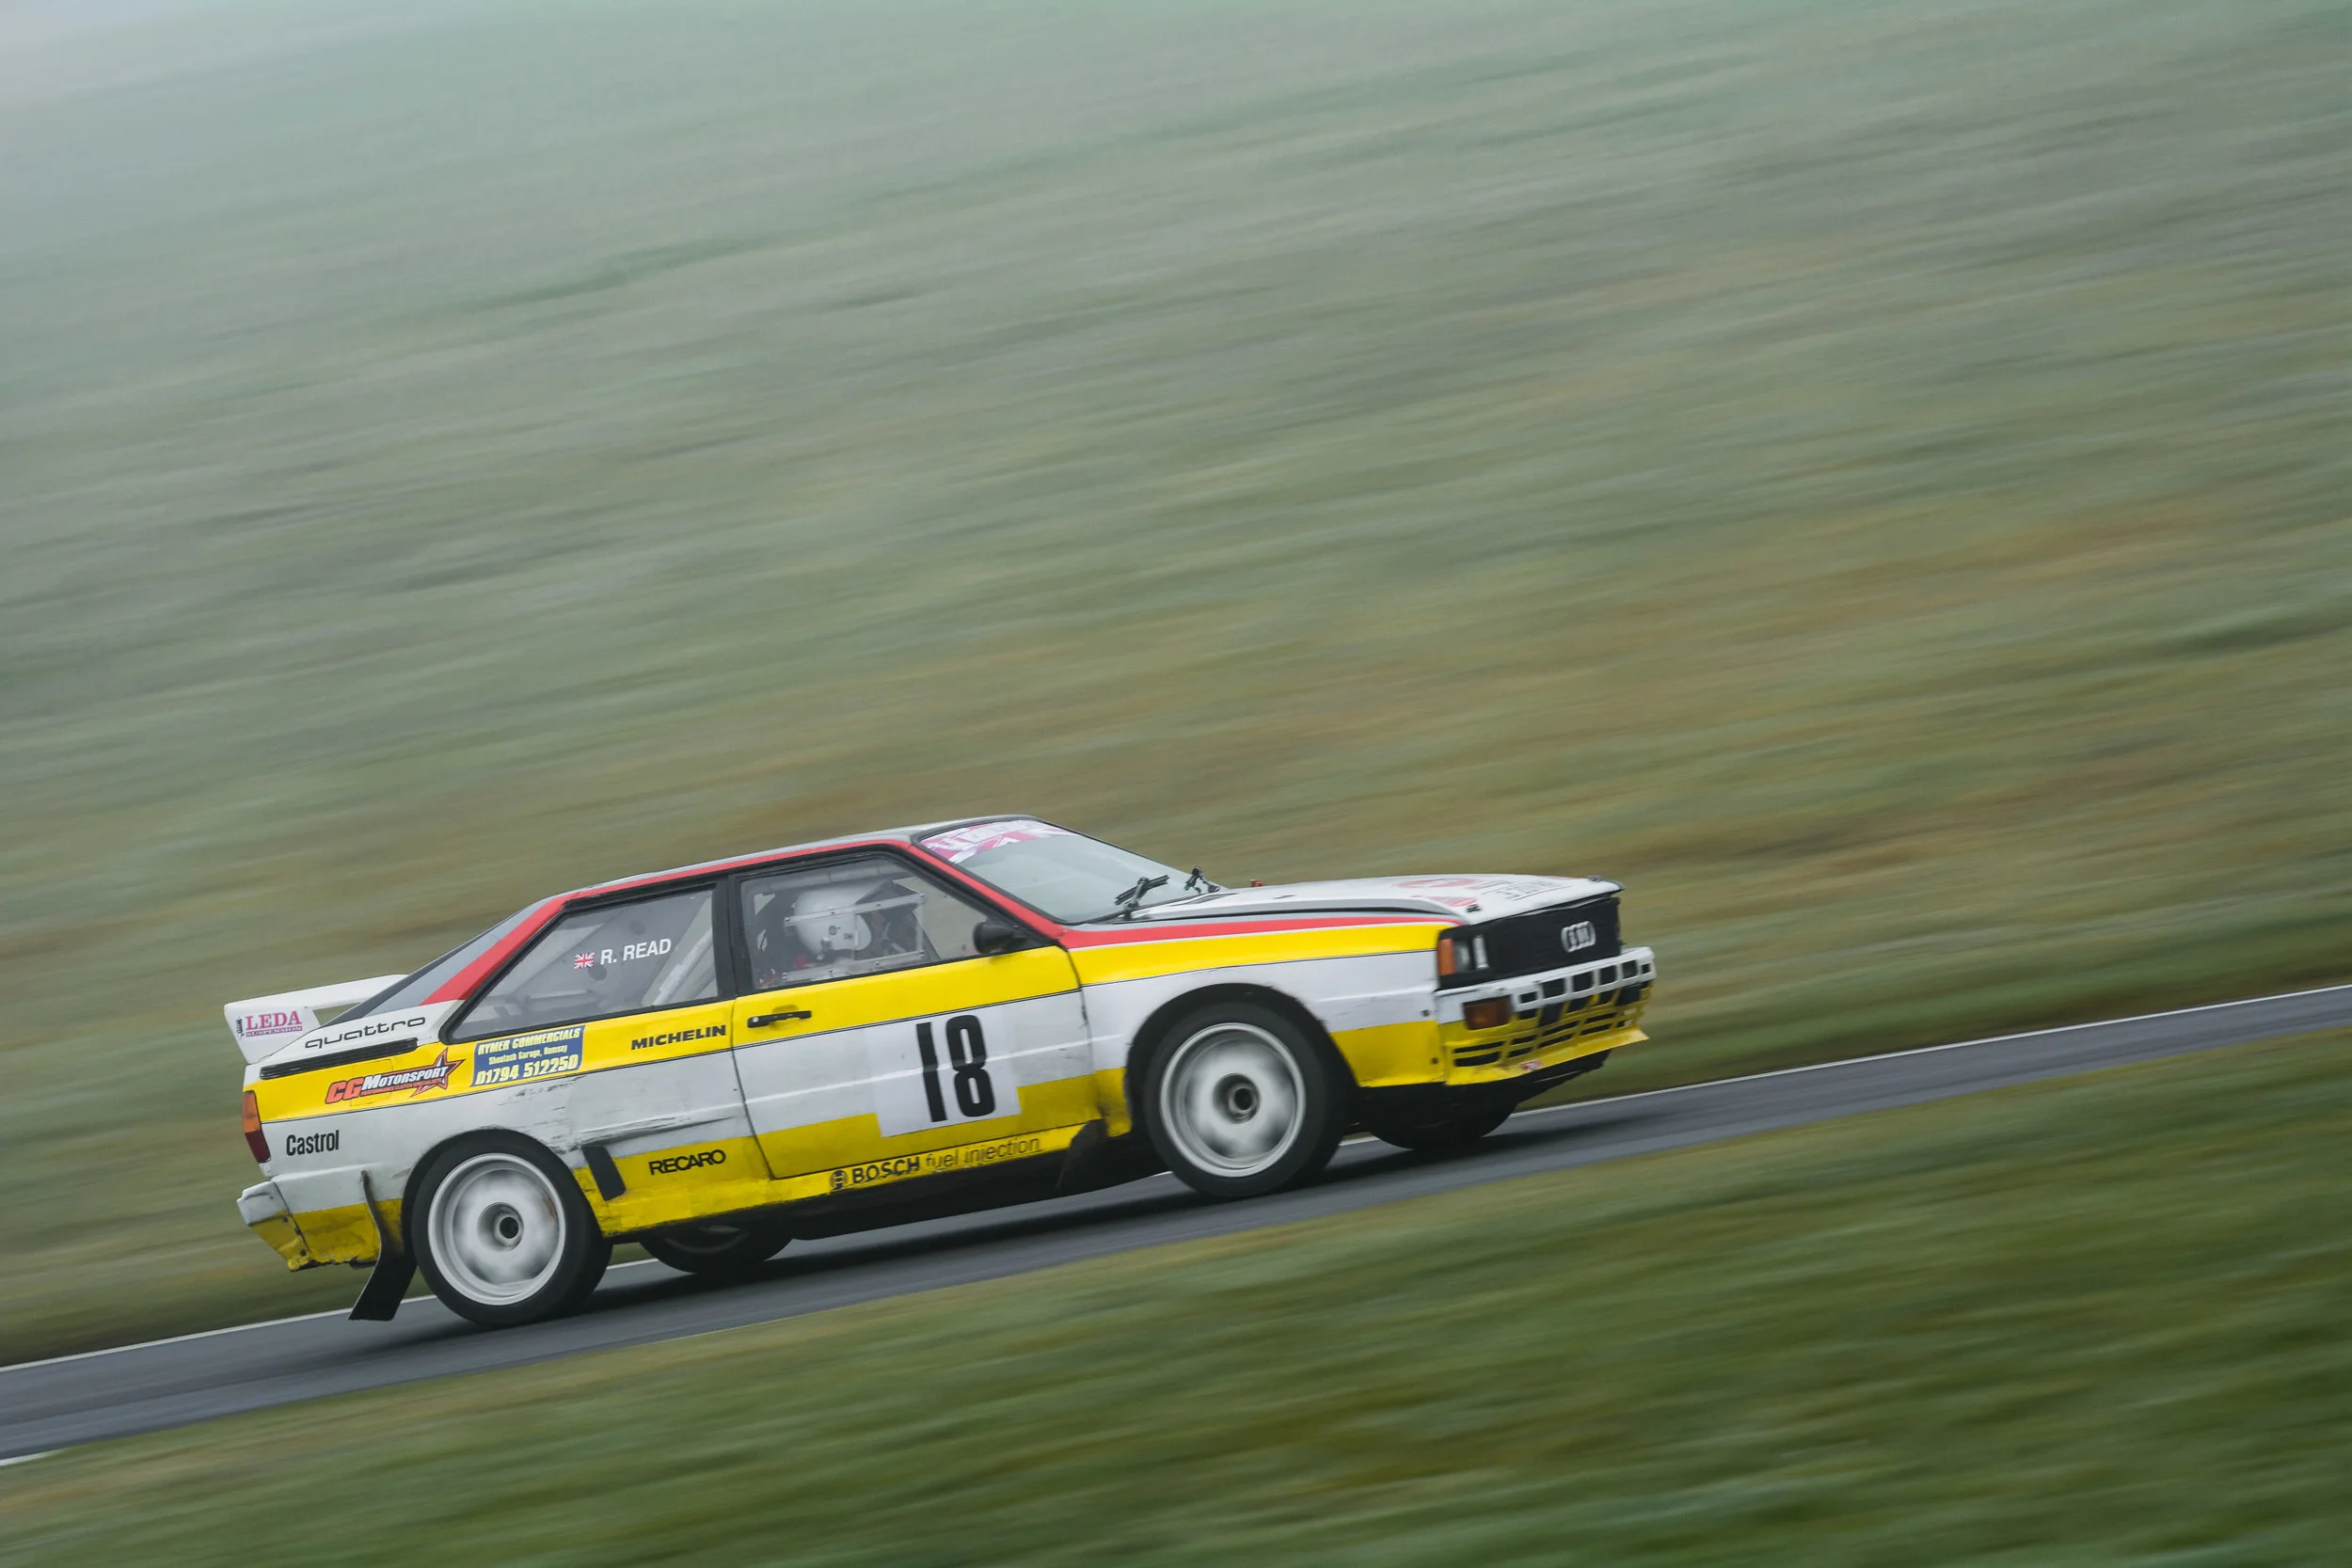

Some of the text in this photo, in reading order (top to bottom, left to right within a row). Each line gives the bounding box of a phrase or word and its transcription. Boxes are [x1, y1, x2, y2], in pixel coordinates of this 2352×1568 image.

[600, 939, 672, 965] R. READ
[246, 1010, 302, 1030] LEDA
[246, 1026, 303, 1037] SUSPENSION
[305, 1017, 426, 1049] quattro
[478, 1028, 581, 1055] RYMER COMMERCIALS
[631, 1024, 726, 1050] MICHELIN
[474, 1053, 579, 1085] 01794 512250
[916, 1014, 995, 1122] 18
[286, 1130, 340, 1156] Castrol
[648, 1149, 726, 1175] RECARO
[851, 1137, 1040, 1184] BOSCH fuel injection
